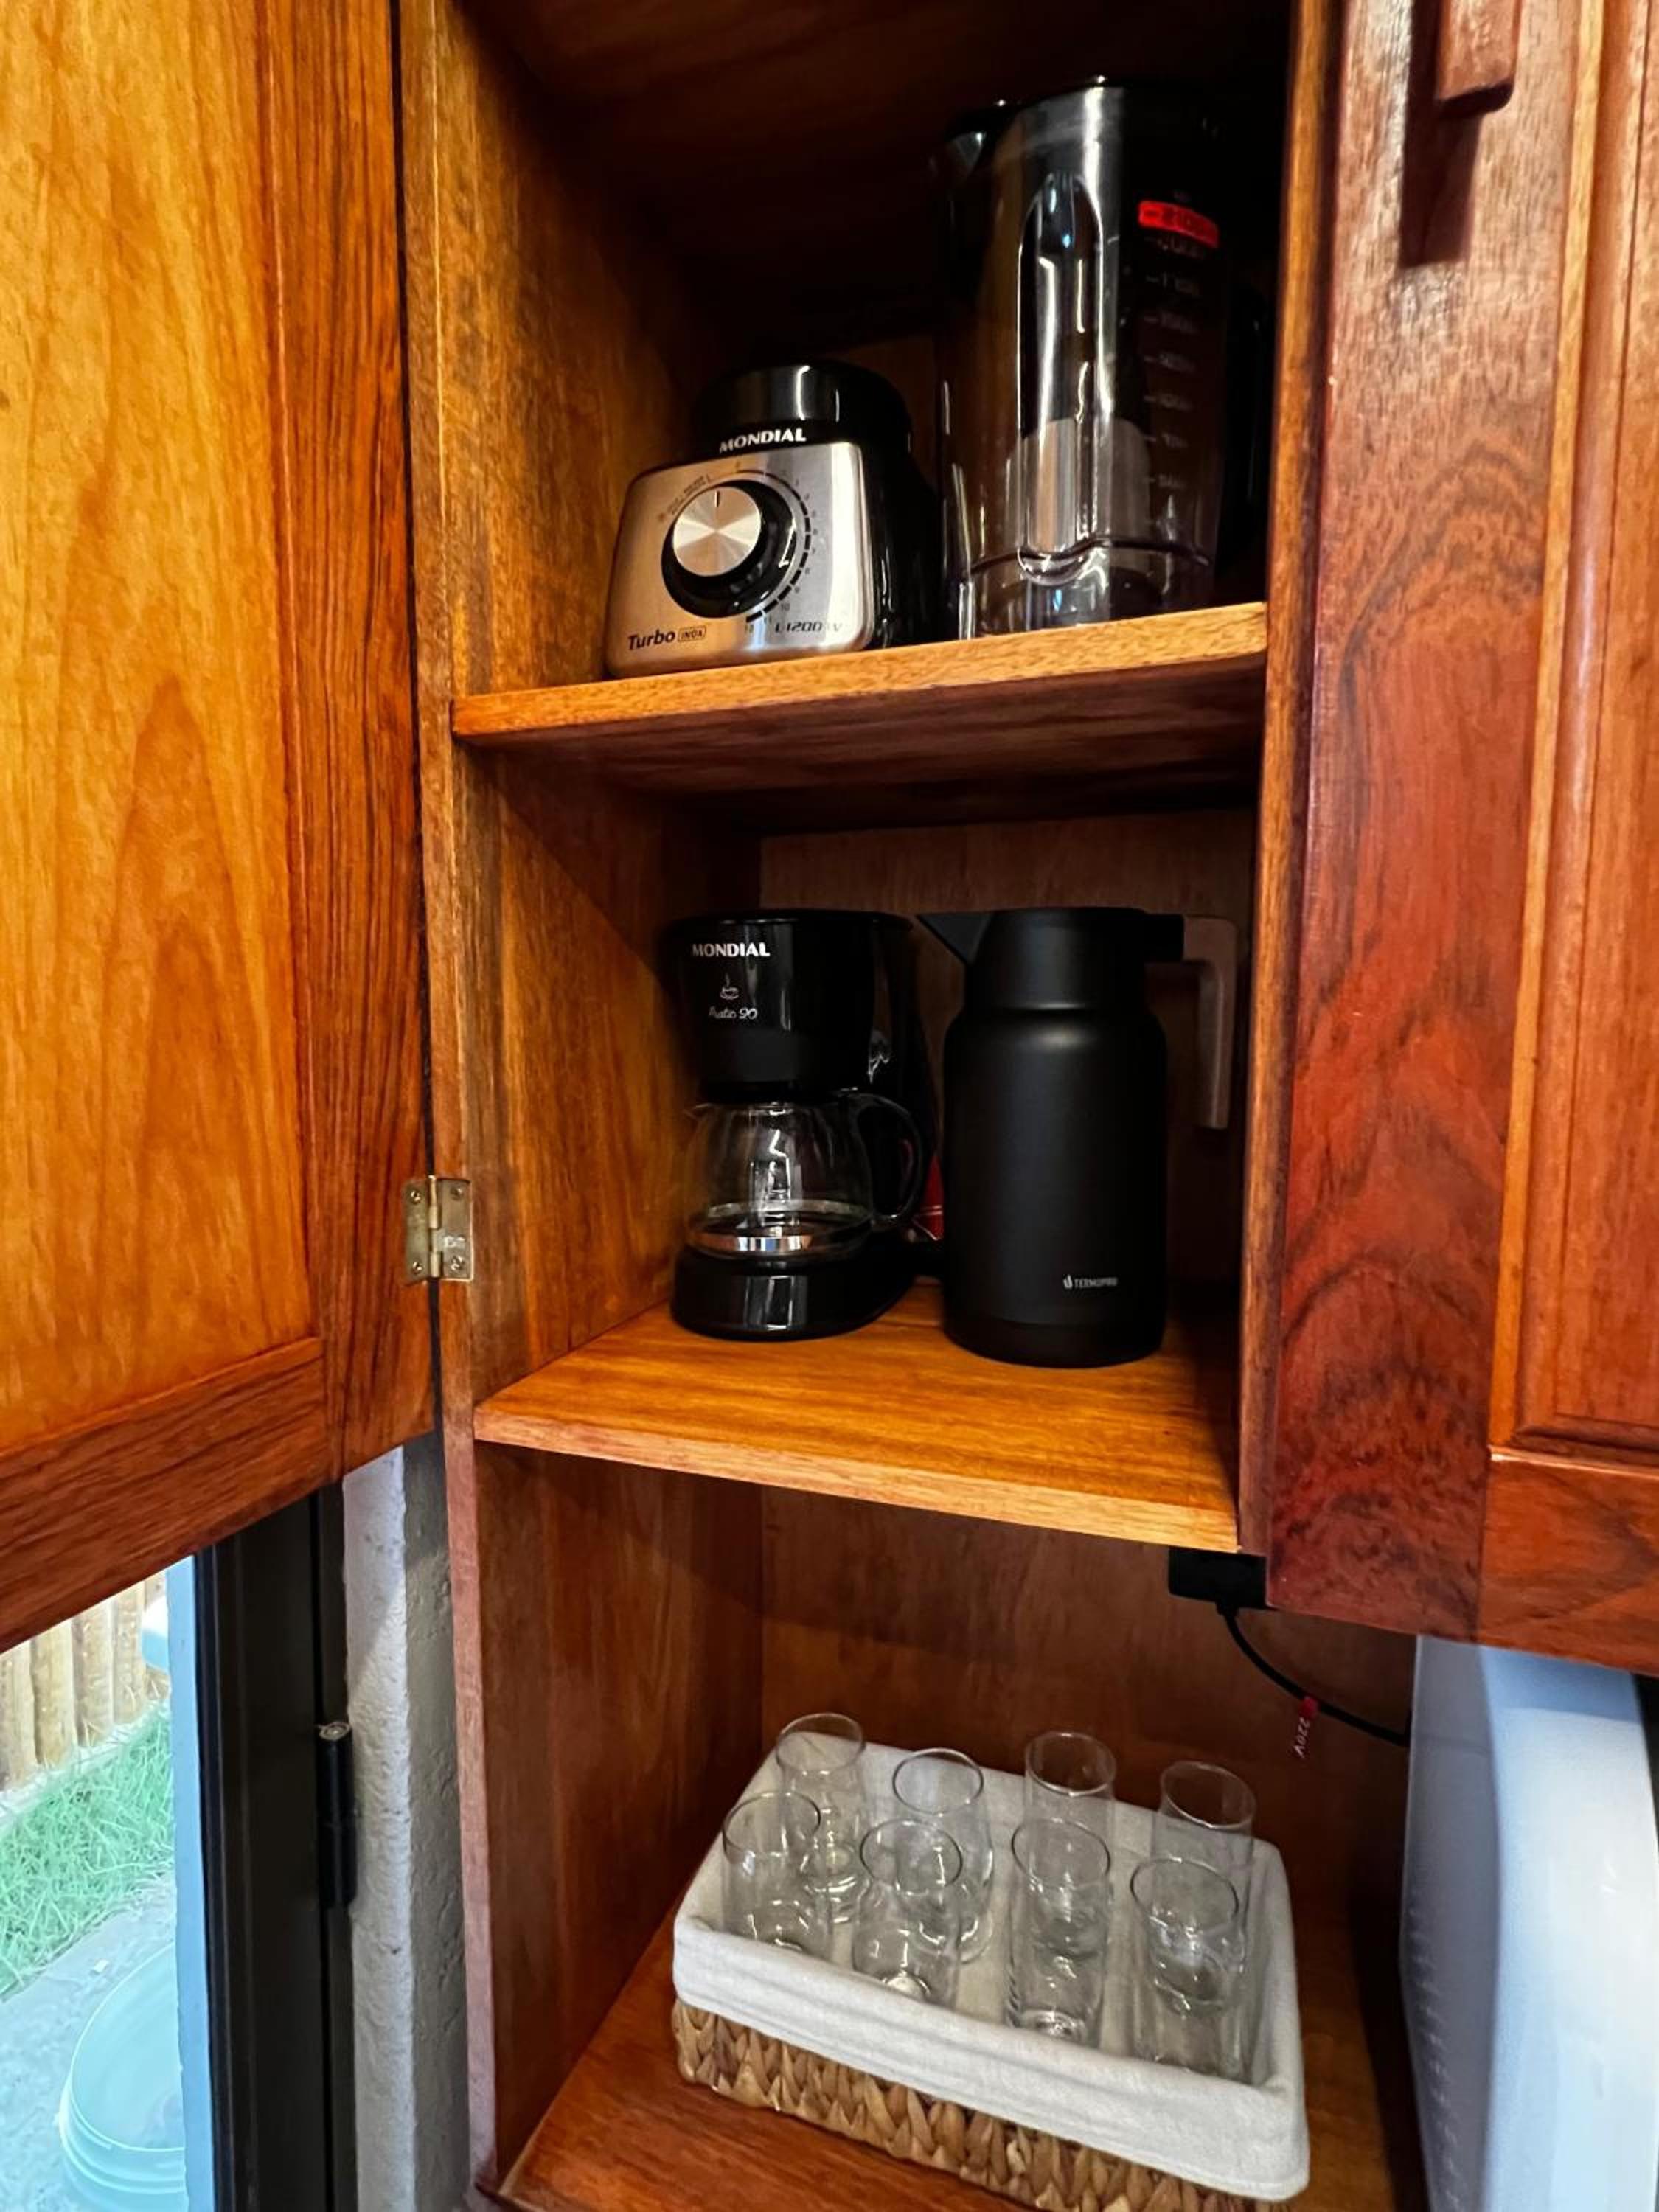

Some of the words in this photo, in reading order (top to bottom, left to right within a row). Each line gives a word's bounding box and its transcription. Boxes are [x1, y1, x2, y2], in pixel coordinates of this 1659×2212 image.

[719, 428, 807, 453] MONDIAL
[627, 628, 676, 650] Turbo
[692, 942, 771, 957] MONDIAL
